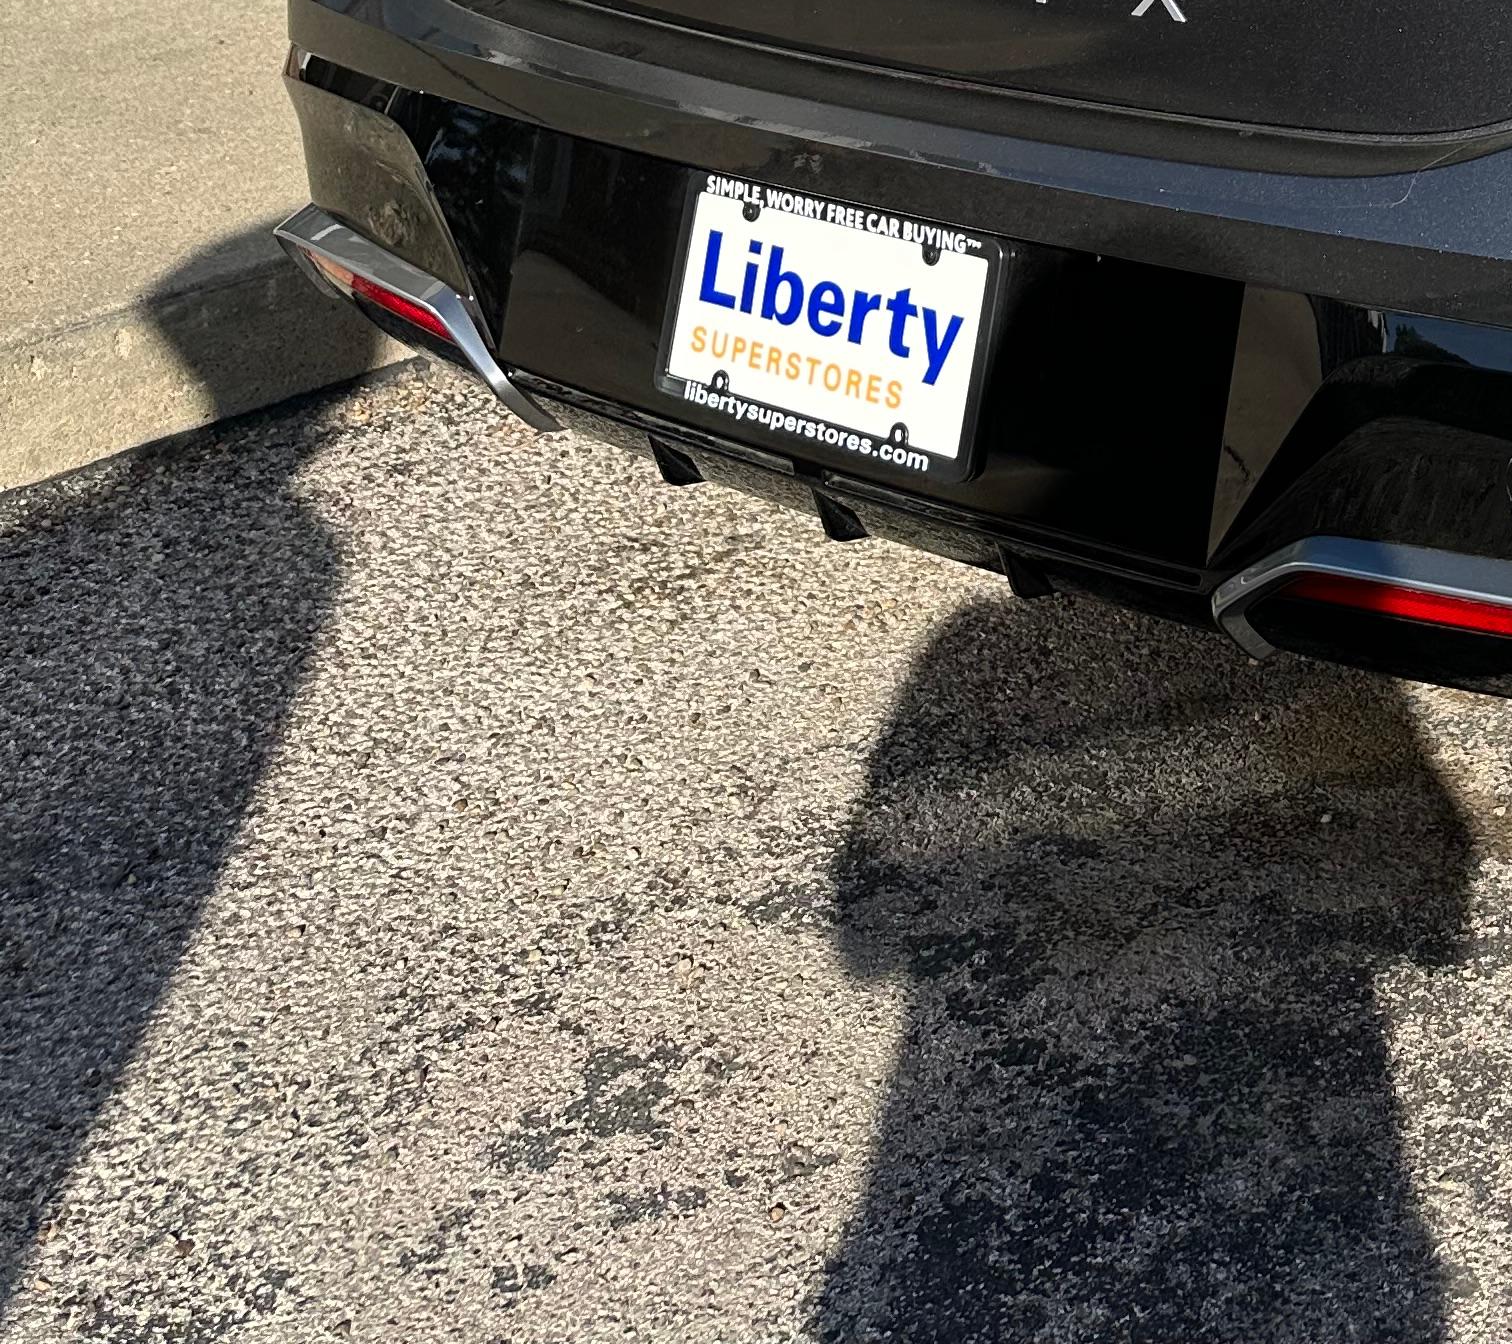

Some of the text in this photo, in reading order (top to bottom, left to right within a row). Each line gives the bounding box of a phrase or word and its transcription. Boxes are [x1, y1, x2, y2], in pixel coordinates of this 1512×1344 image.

[705, 174, 765, 209] SIMPLE,
[765, 188, 826, 220] WORRY
[826, 203, 865, 231] FREE
[866, 213, 900, 239] CAR
[699, 229, 965, 386] Liberty
[691, 325, 903, 410] SUPERSTORES
[684, 380, 930, 472] libertysuperstores.com
